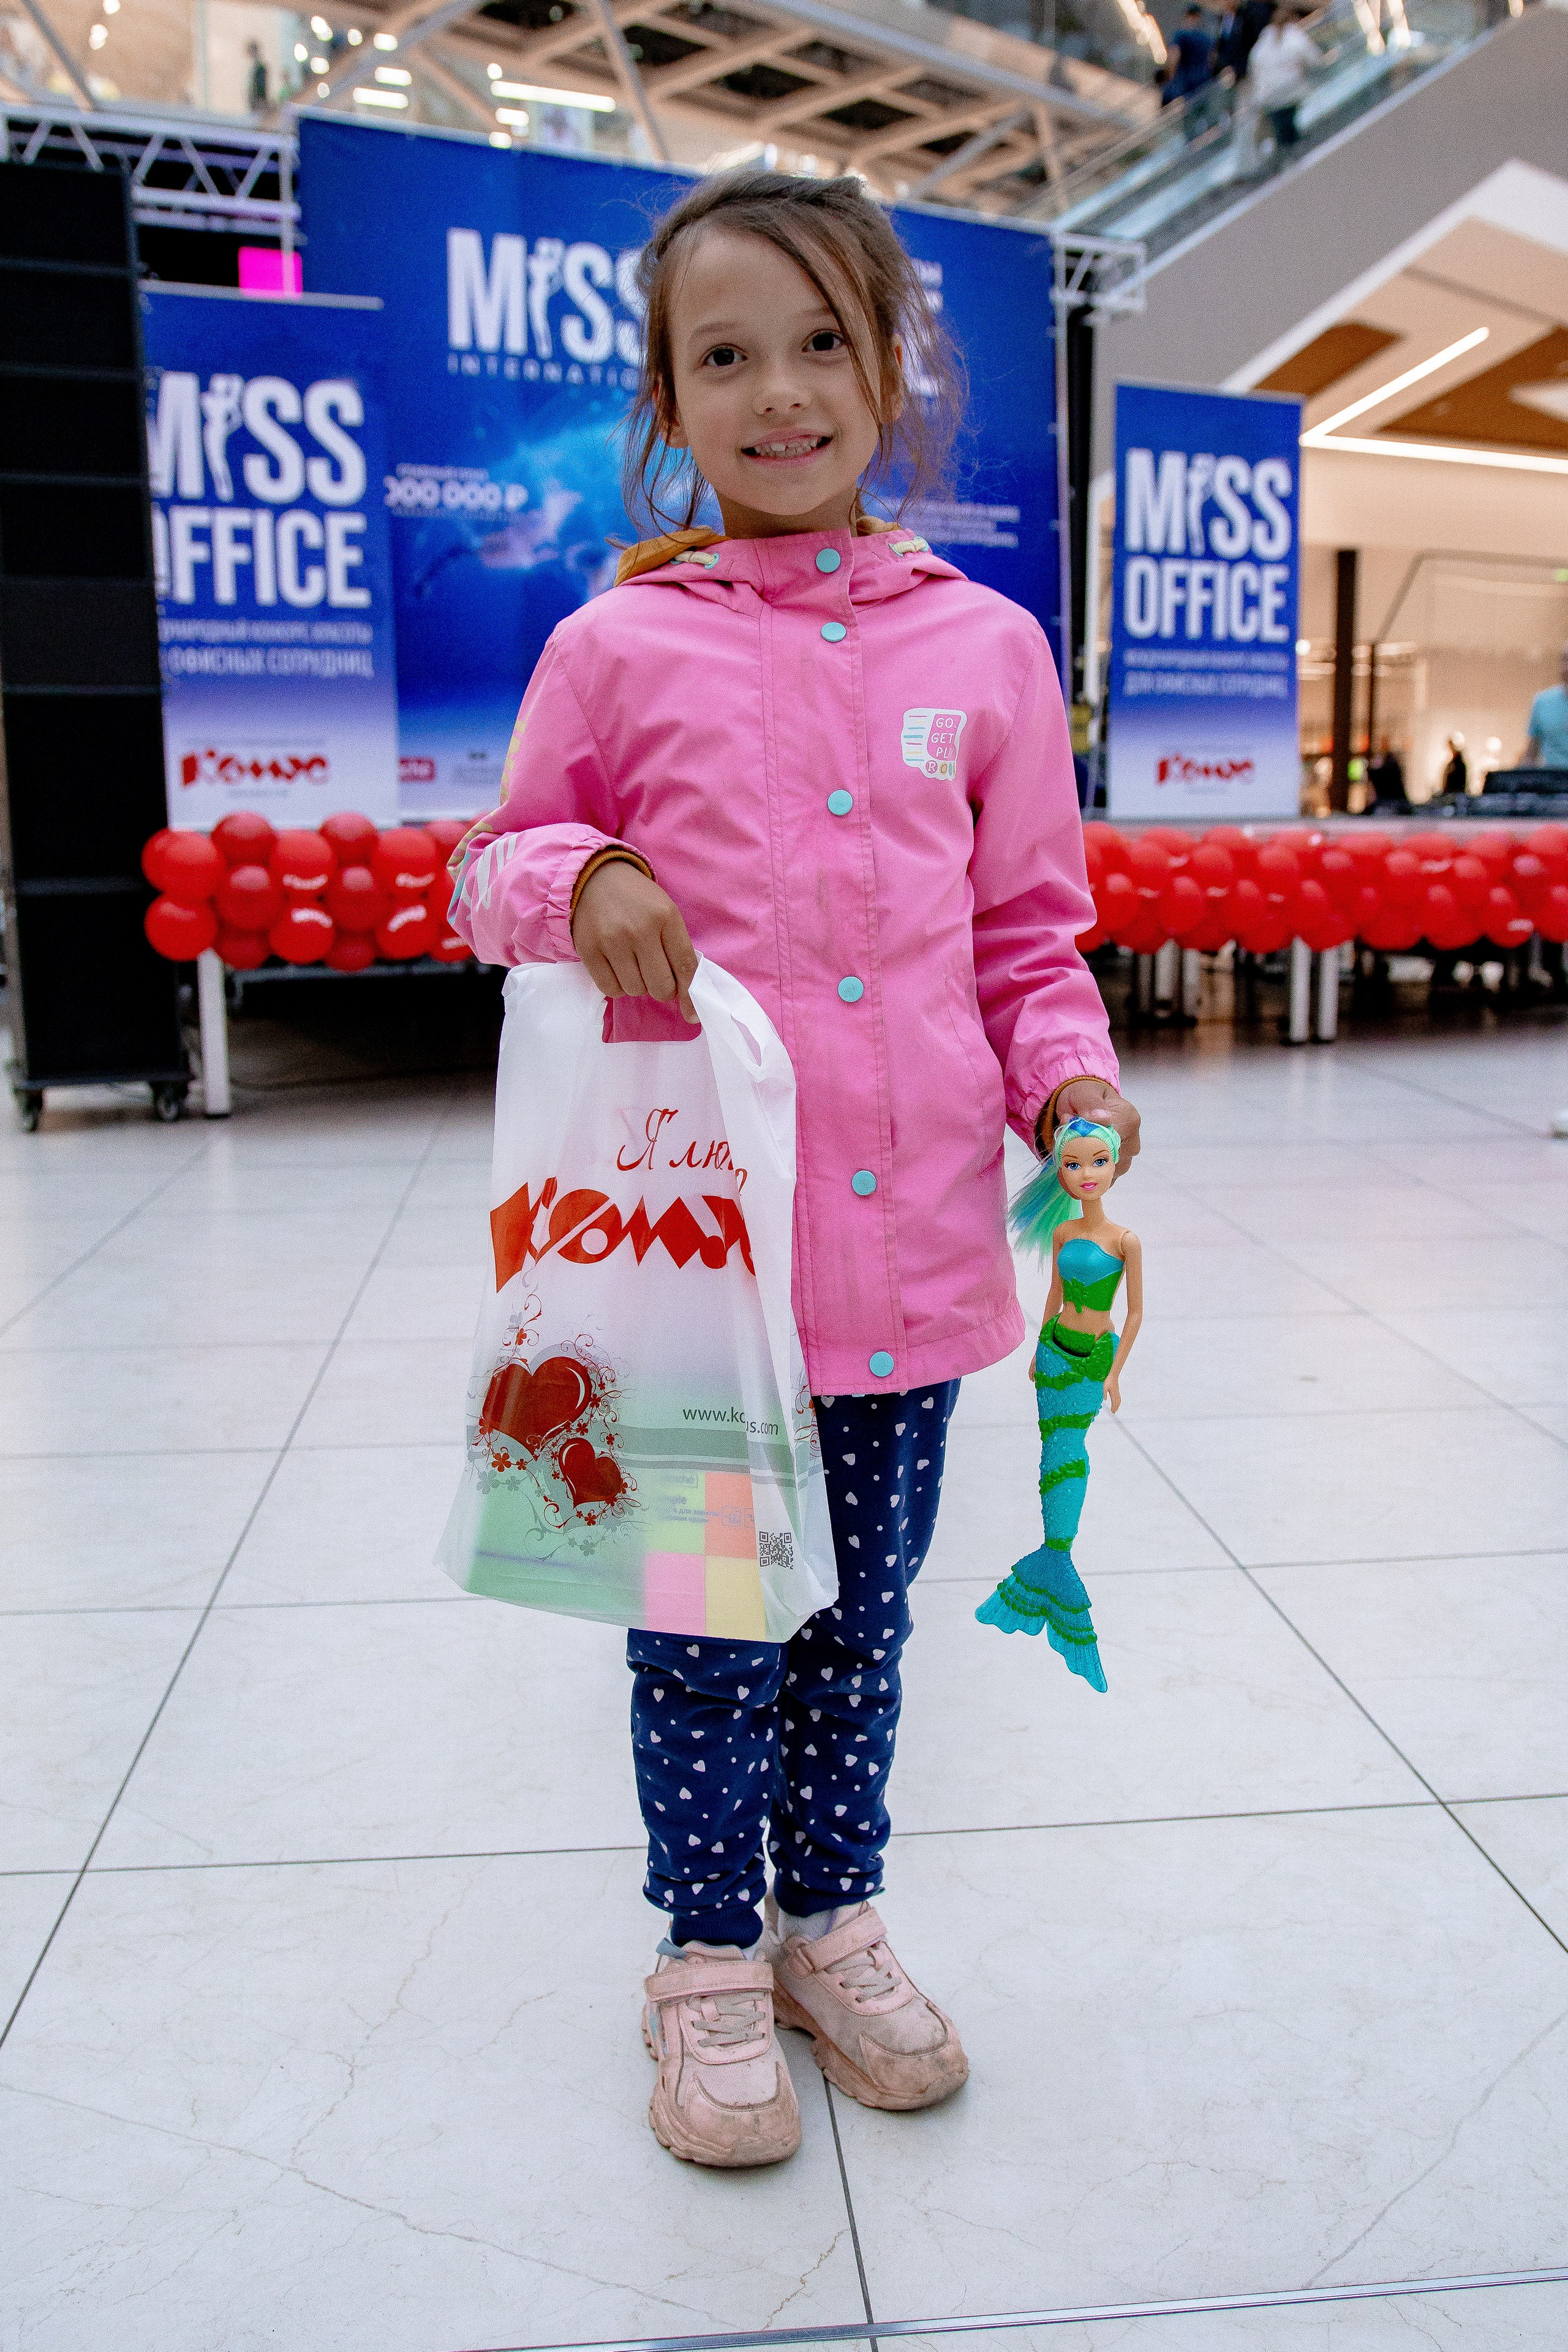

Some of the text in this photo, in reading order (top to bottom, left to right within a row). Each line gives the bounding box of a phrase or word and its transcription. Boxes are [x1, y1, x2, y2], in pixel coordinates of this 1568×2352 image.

[447, 352, 641, 391] INTERNATIO
[1125, 447, 1292, 562] MISS
[1123, 555, 1290, 643] OFFICE
[930, 733, 954, 744] GET
[936, 746, 954, 759] PL
[617, 1108, 679, 1171] Я
